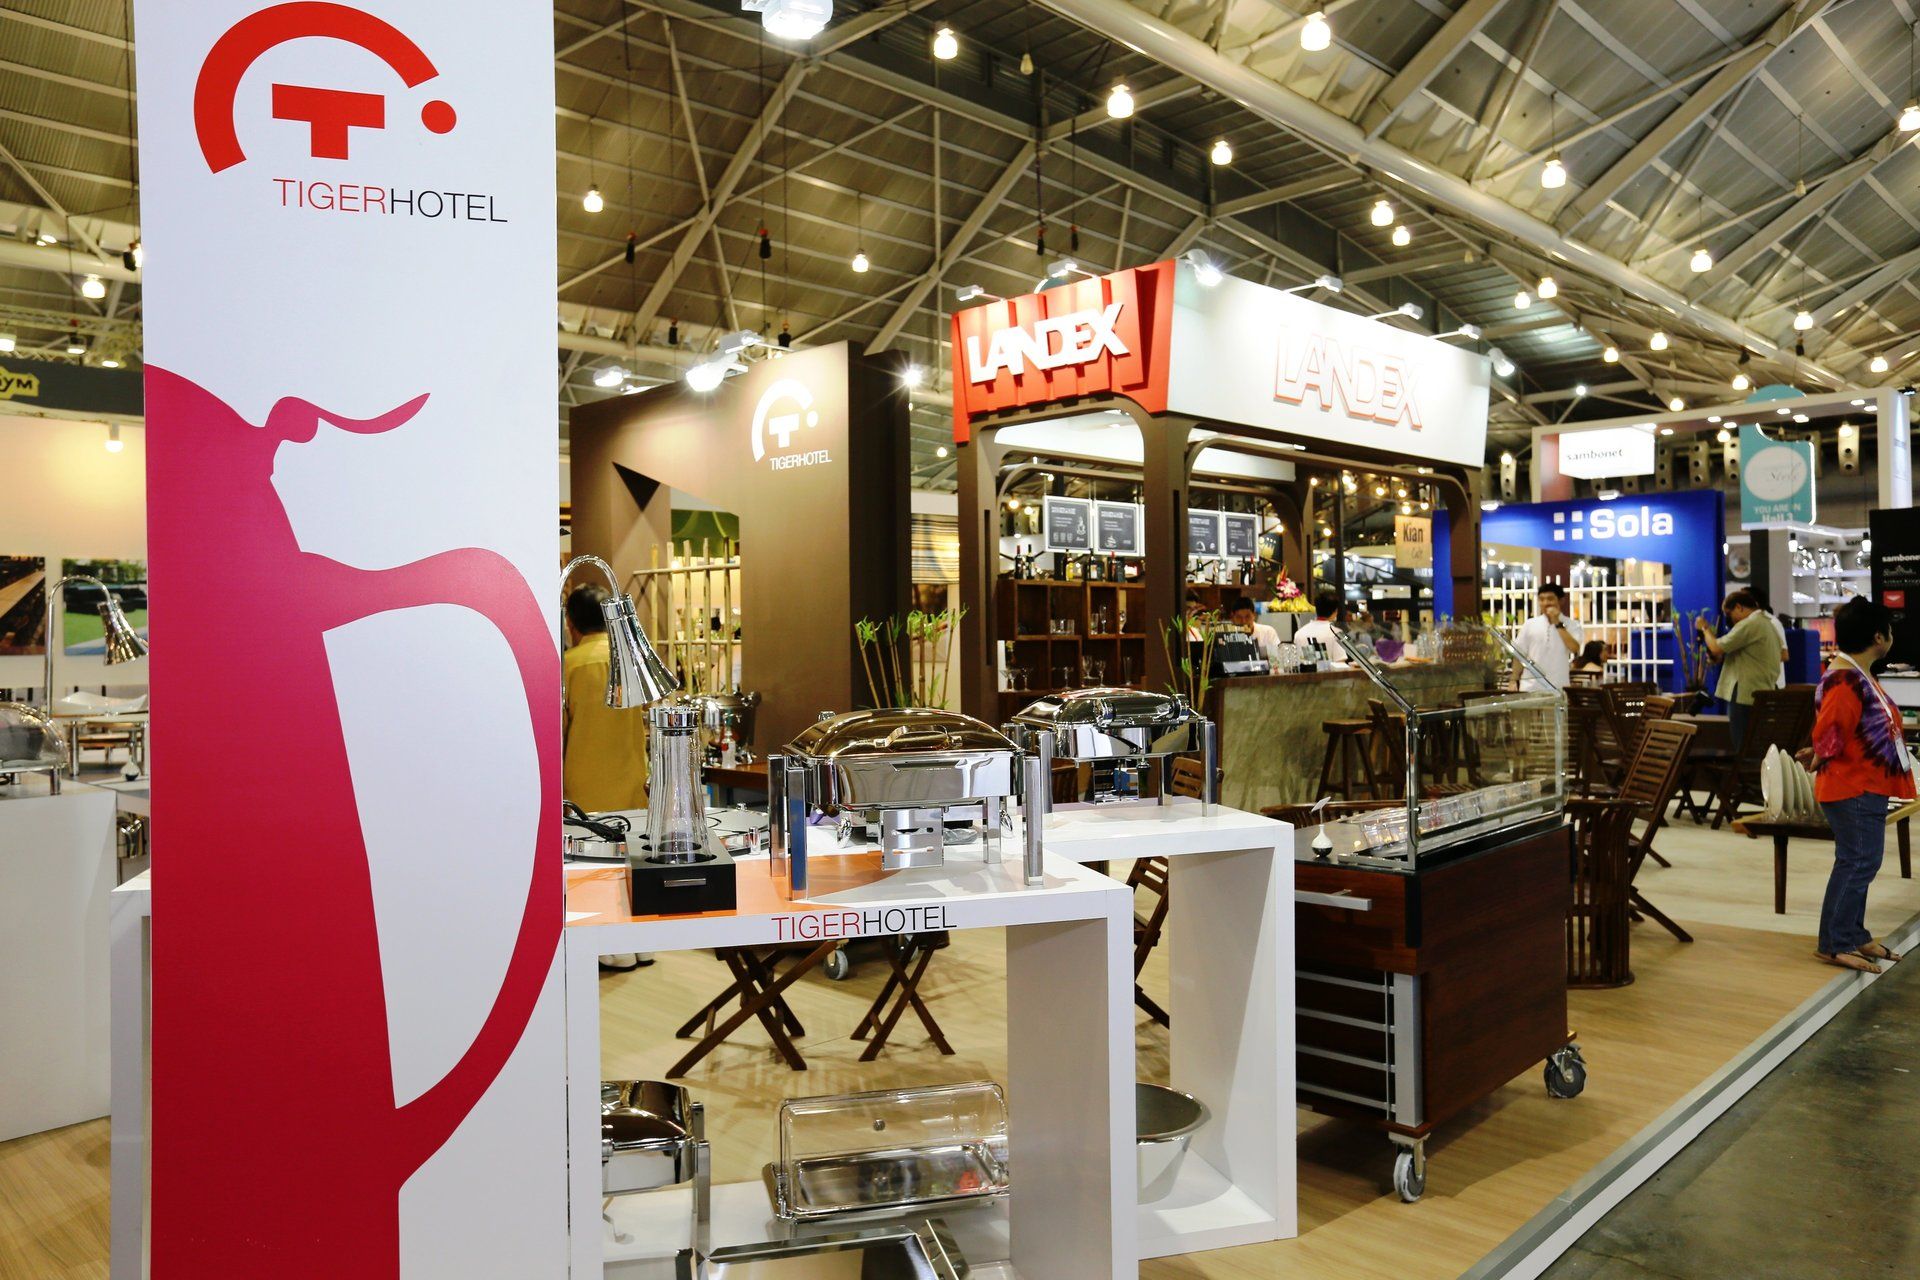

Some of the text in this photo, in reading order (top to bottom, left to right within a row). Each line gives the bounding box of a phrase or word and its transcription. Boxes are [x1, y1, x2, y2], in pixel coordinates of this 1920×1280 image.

[272, 178, 508, 222] TIGERHOTEL
[967, 302, 1131, 384] LANDEX
[1274, 324, 1423, 431] LANDEX
[769, 450, 832, 471] TIGERHOTEL
[1567, 449, 1623, 460] sambonet
[1403, 523, 1423, 543] Kian
[1589, 506, 1673, 539] Sola
[771, 906, 957, 941] TIGERHOTEL
